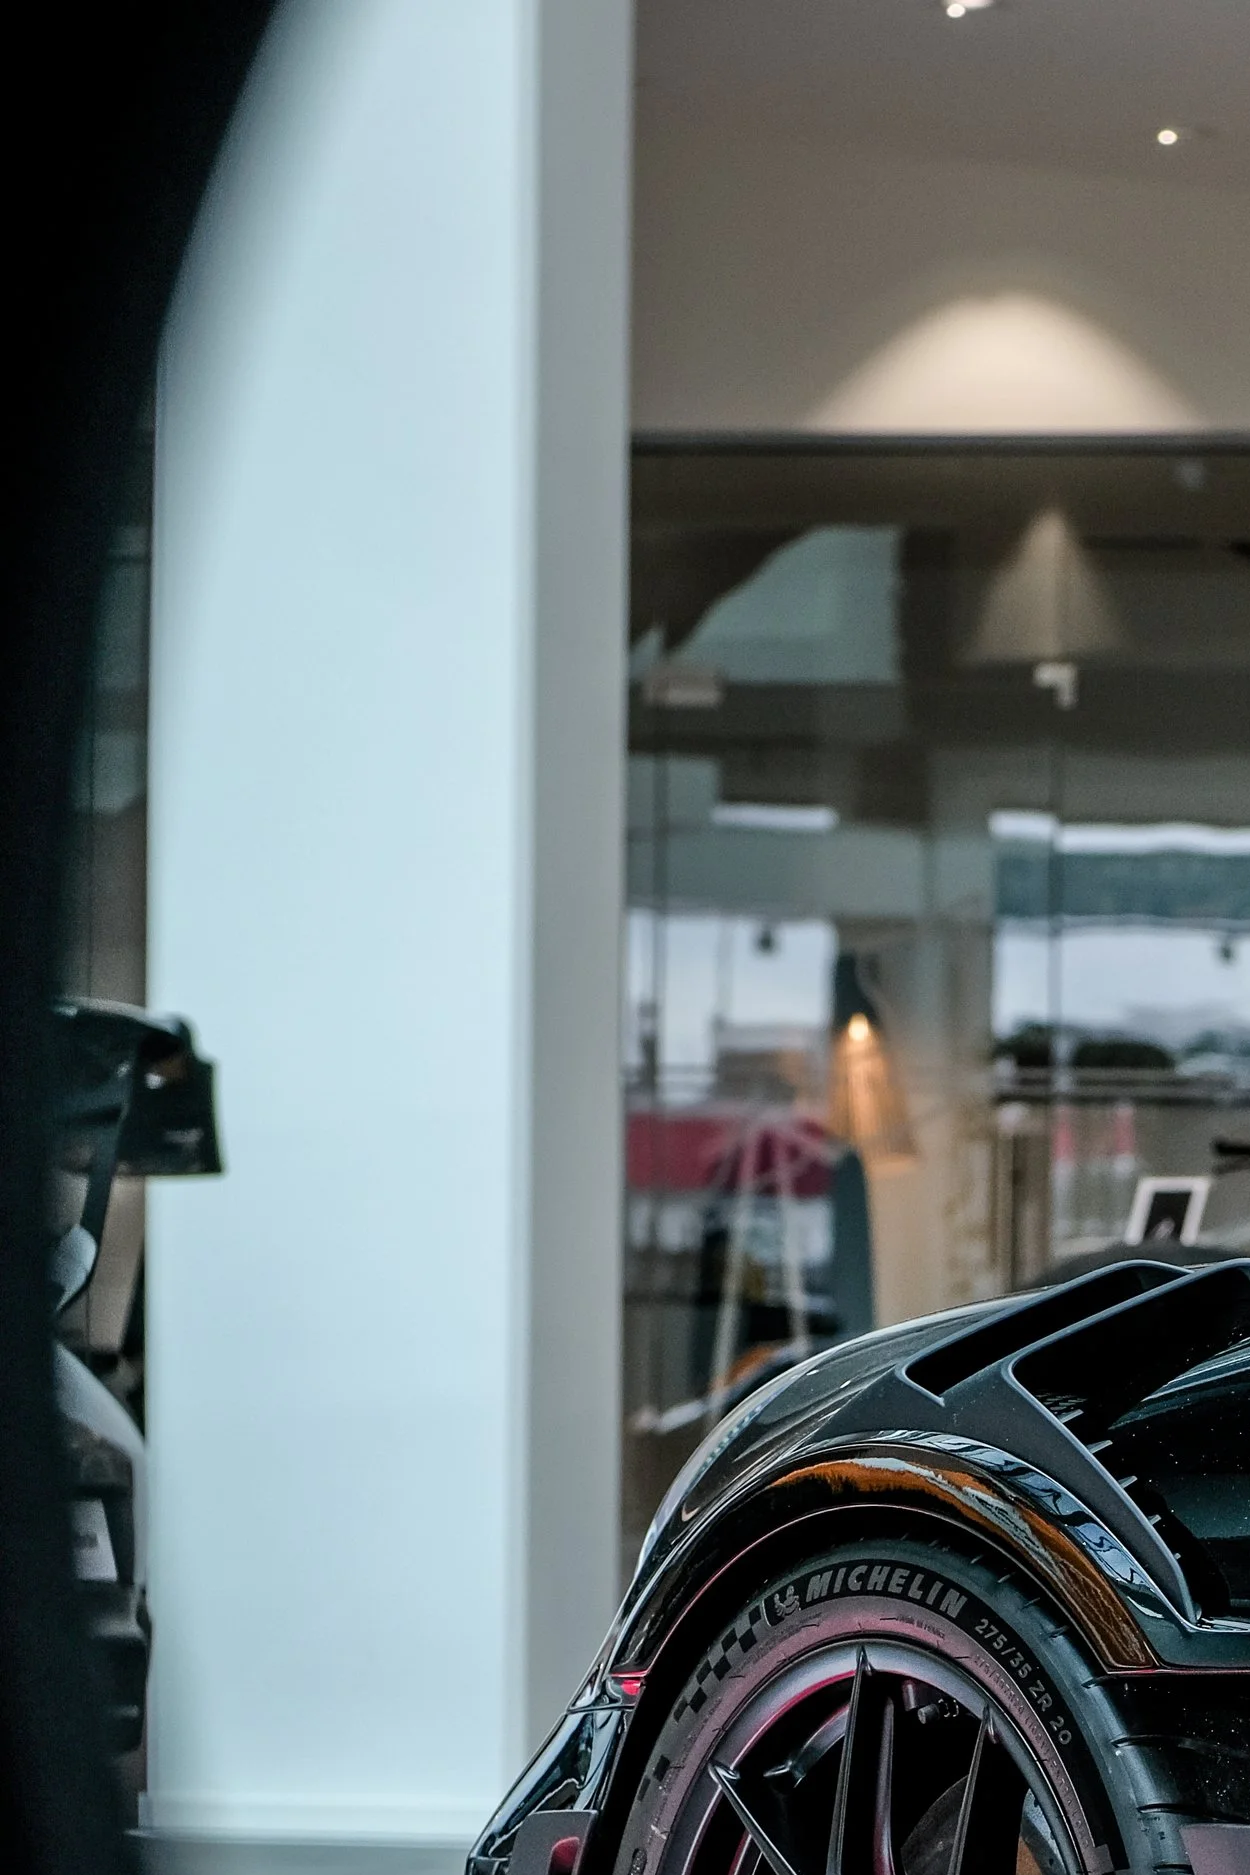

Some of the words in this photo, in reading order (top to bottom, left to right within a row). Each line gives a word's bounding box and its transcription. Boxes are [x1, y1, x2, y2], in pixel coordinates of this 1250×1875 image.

[805, 1565, 968, 1619] MICHELIN
[974, 1617, 1034, 1679] 275/35
[1028, 1680, 1055, 1713] ZR
[1049, 1716, 1073, 1746] 20
